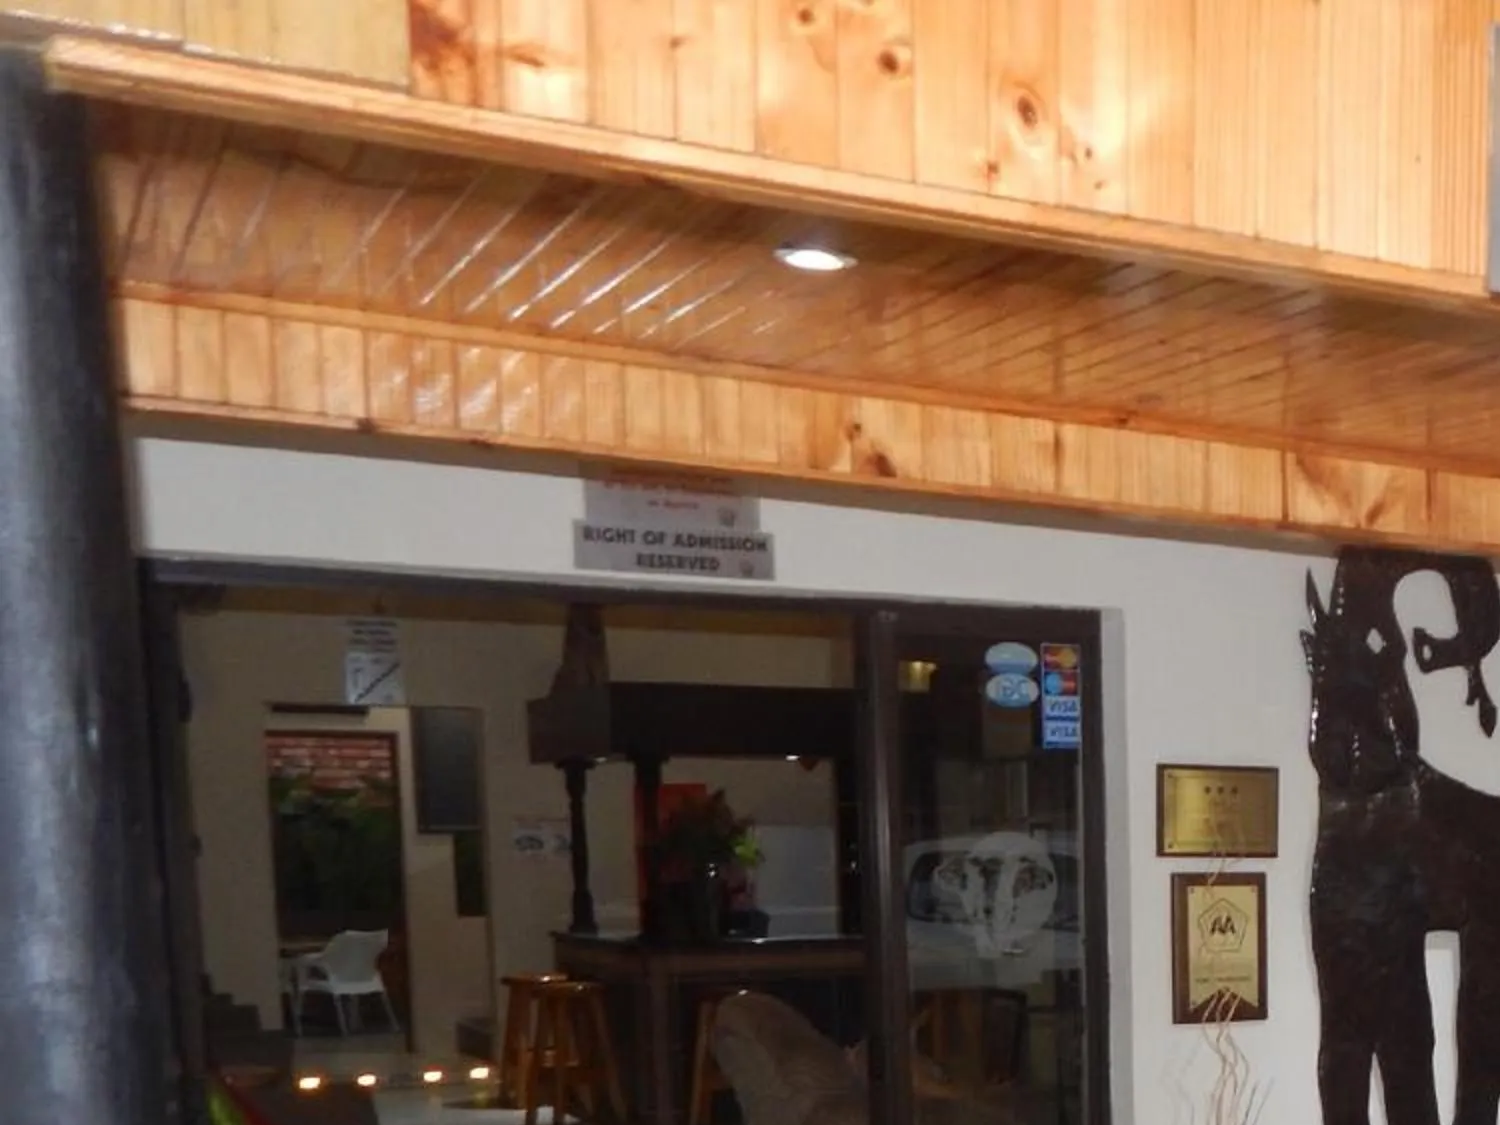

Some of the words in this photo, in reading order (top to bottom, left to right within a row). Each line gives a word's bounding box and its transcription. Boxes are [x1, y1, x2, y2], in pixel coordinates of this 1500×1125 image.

[582, 525, 636, 545] RIGHT
[643, 530, 668, 546] OF
[673, 533, 769, 551] ADMISSION
[636, 553, 720, 571] RESERVED
[1049, 700, 1078, 713] VISA
